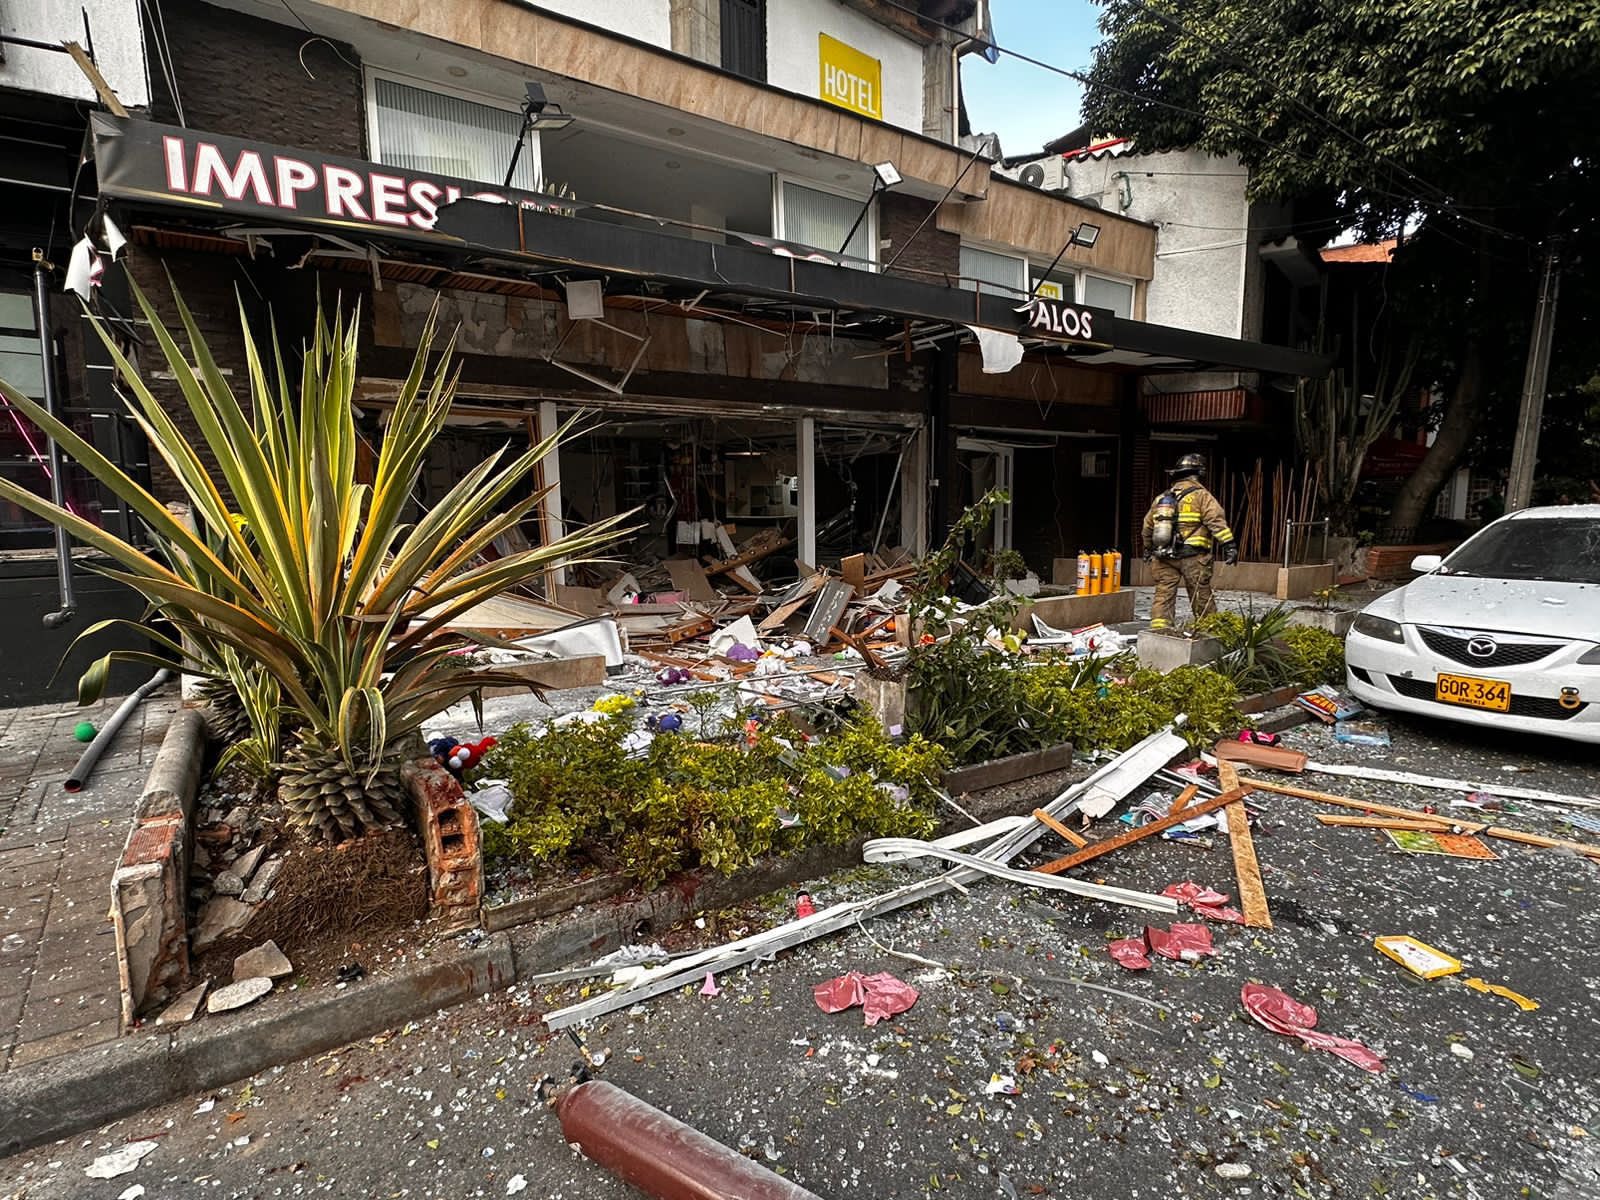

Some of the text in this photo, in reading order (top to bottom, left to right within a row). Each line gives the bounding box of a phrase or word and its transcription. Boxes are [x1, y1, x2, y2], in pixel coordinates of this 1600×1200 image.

[824, 62, 877, 114] HOTEL
[1029, 302, 1093, 340] ALOS
[1474, 683, 1507, 703] 364
